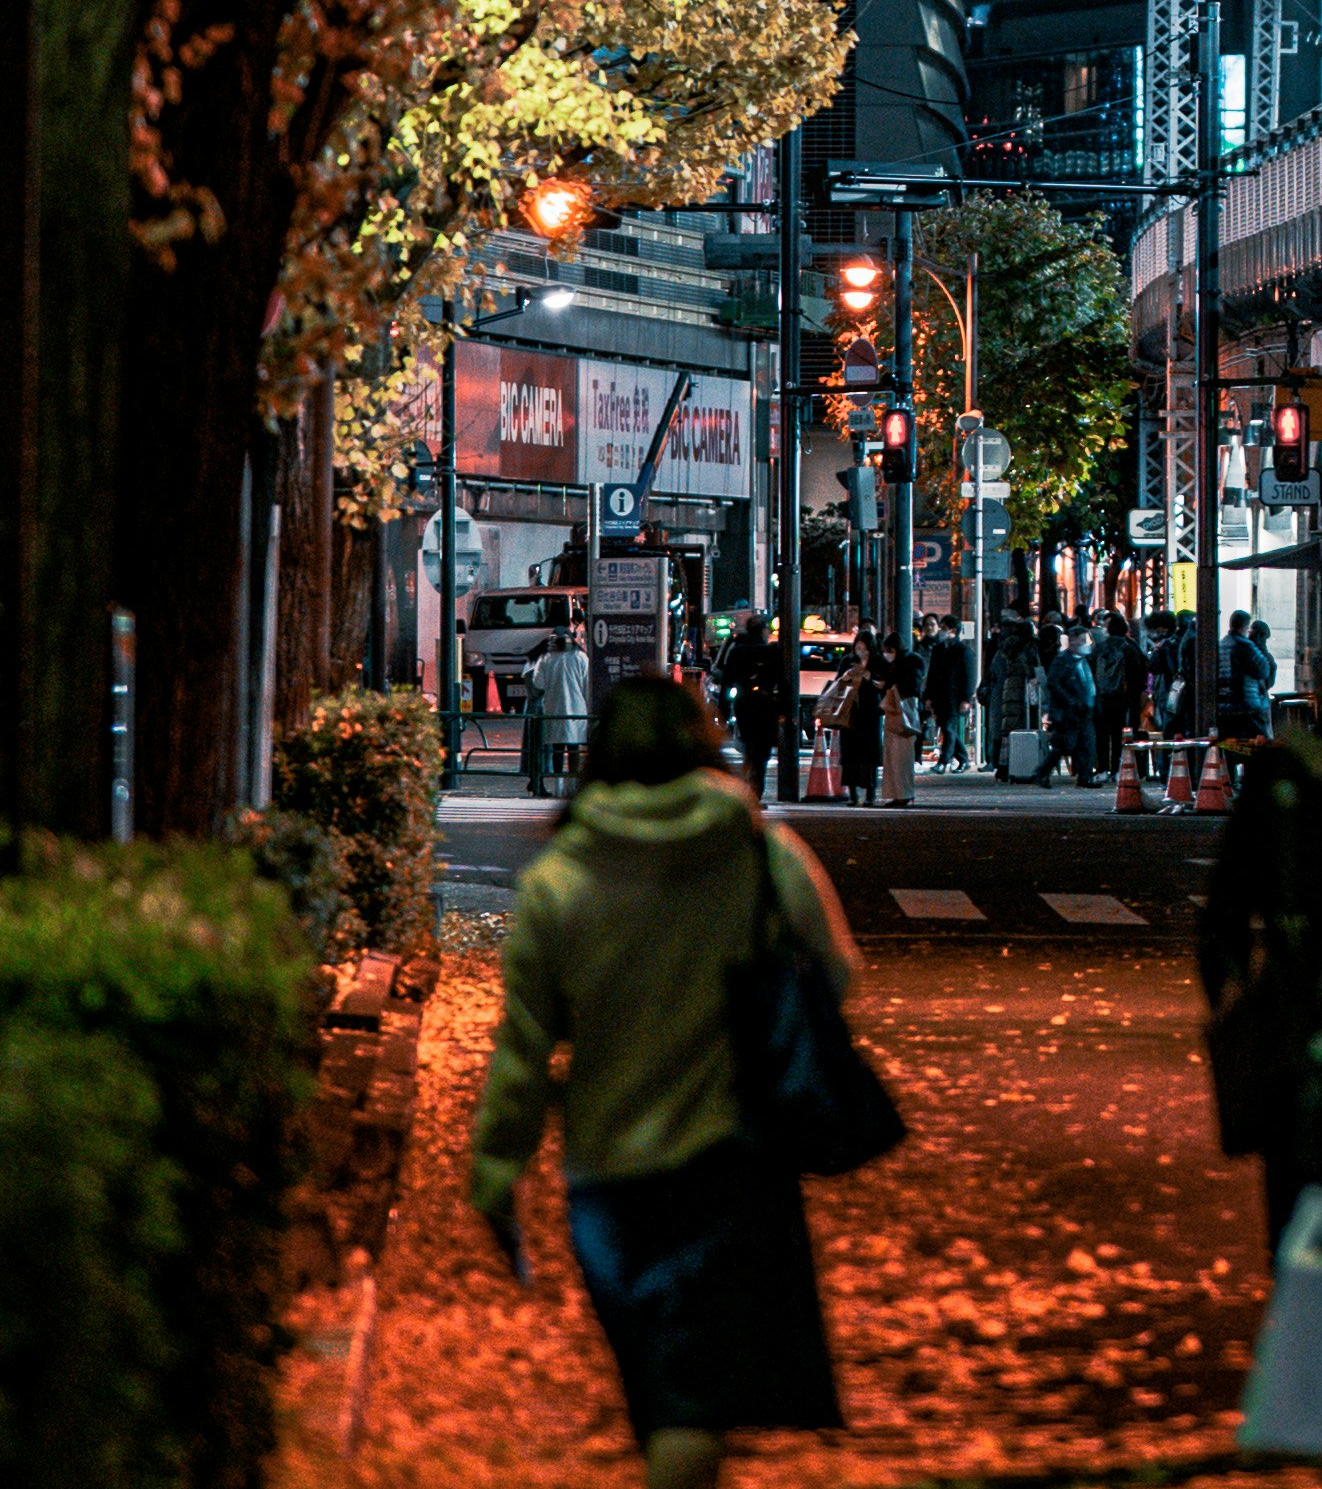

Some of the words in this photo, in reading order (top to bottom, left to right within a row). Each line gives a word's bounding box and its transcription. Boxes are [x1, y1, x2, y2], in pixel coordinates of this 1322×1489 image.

[500, 380, 518, 443] BIC
[520, 386, 564, 447] CAMERA
[692, 406, 741, 466] CAMERA
[1271, 483, 1311, 500] STAND
